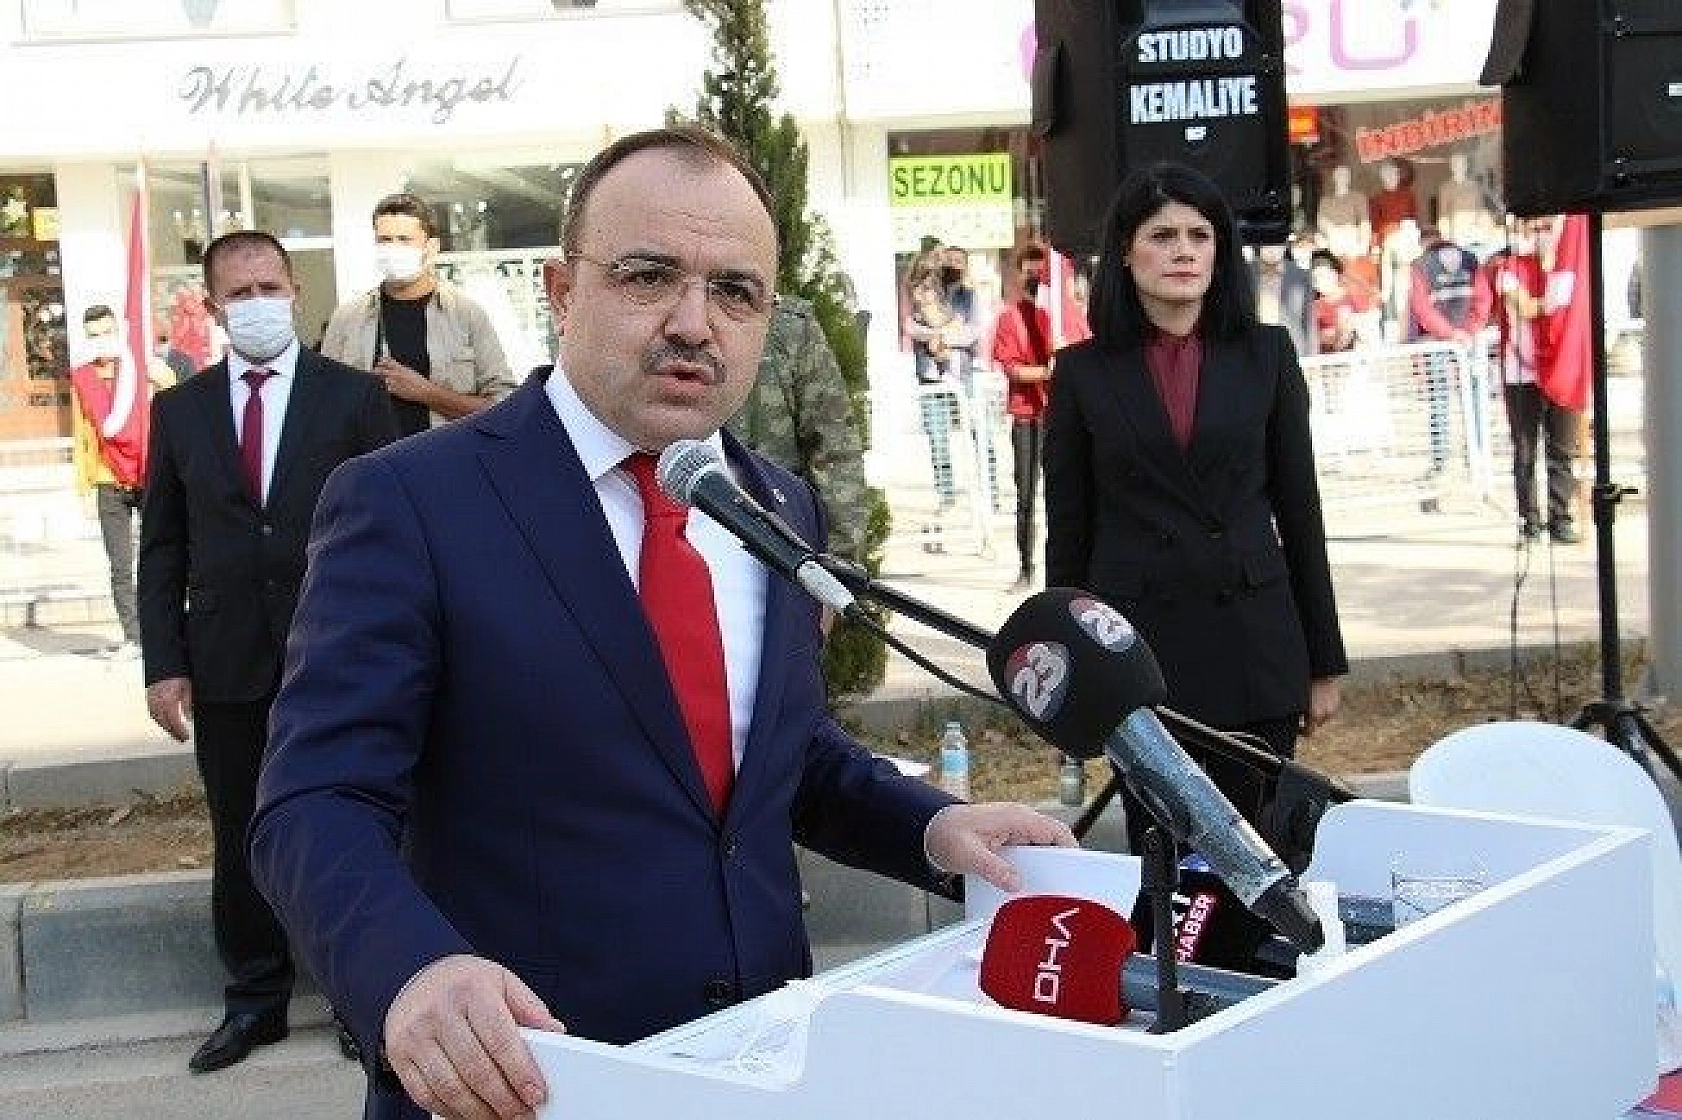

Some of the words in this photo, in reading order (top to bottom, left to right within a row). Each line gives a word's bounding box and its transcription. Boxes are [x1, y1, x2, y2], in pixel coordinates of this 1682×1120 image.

[1137, 26, 1243, 63] STUDYO
[179, 64, 334, 114] White
[348, 52, 524, 124] Angel
[893, 162, 1006, 197] SEZONU
[1011, 642, 1067, 718] 23
[1177, 893, 1215, 963] HABER
